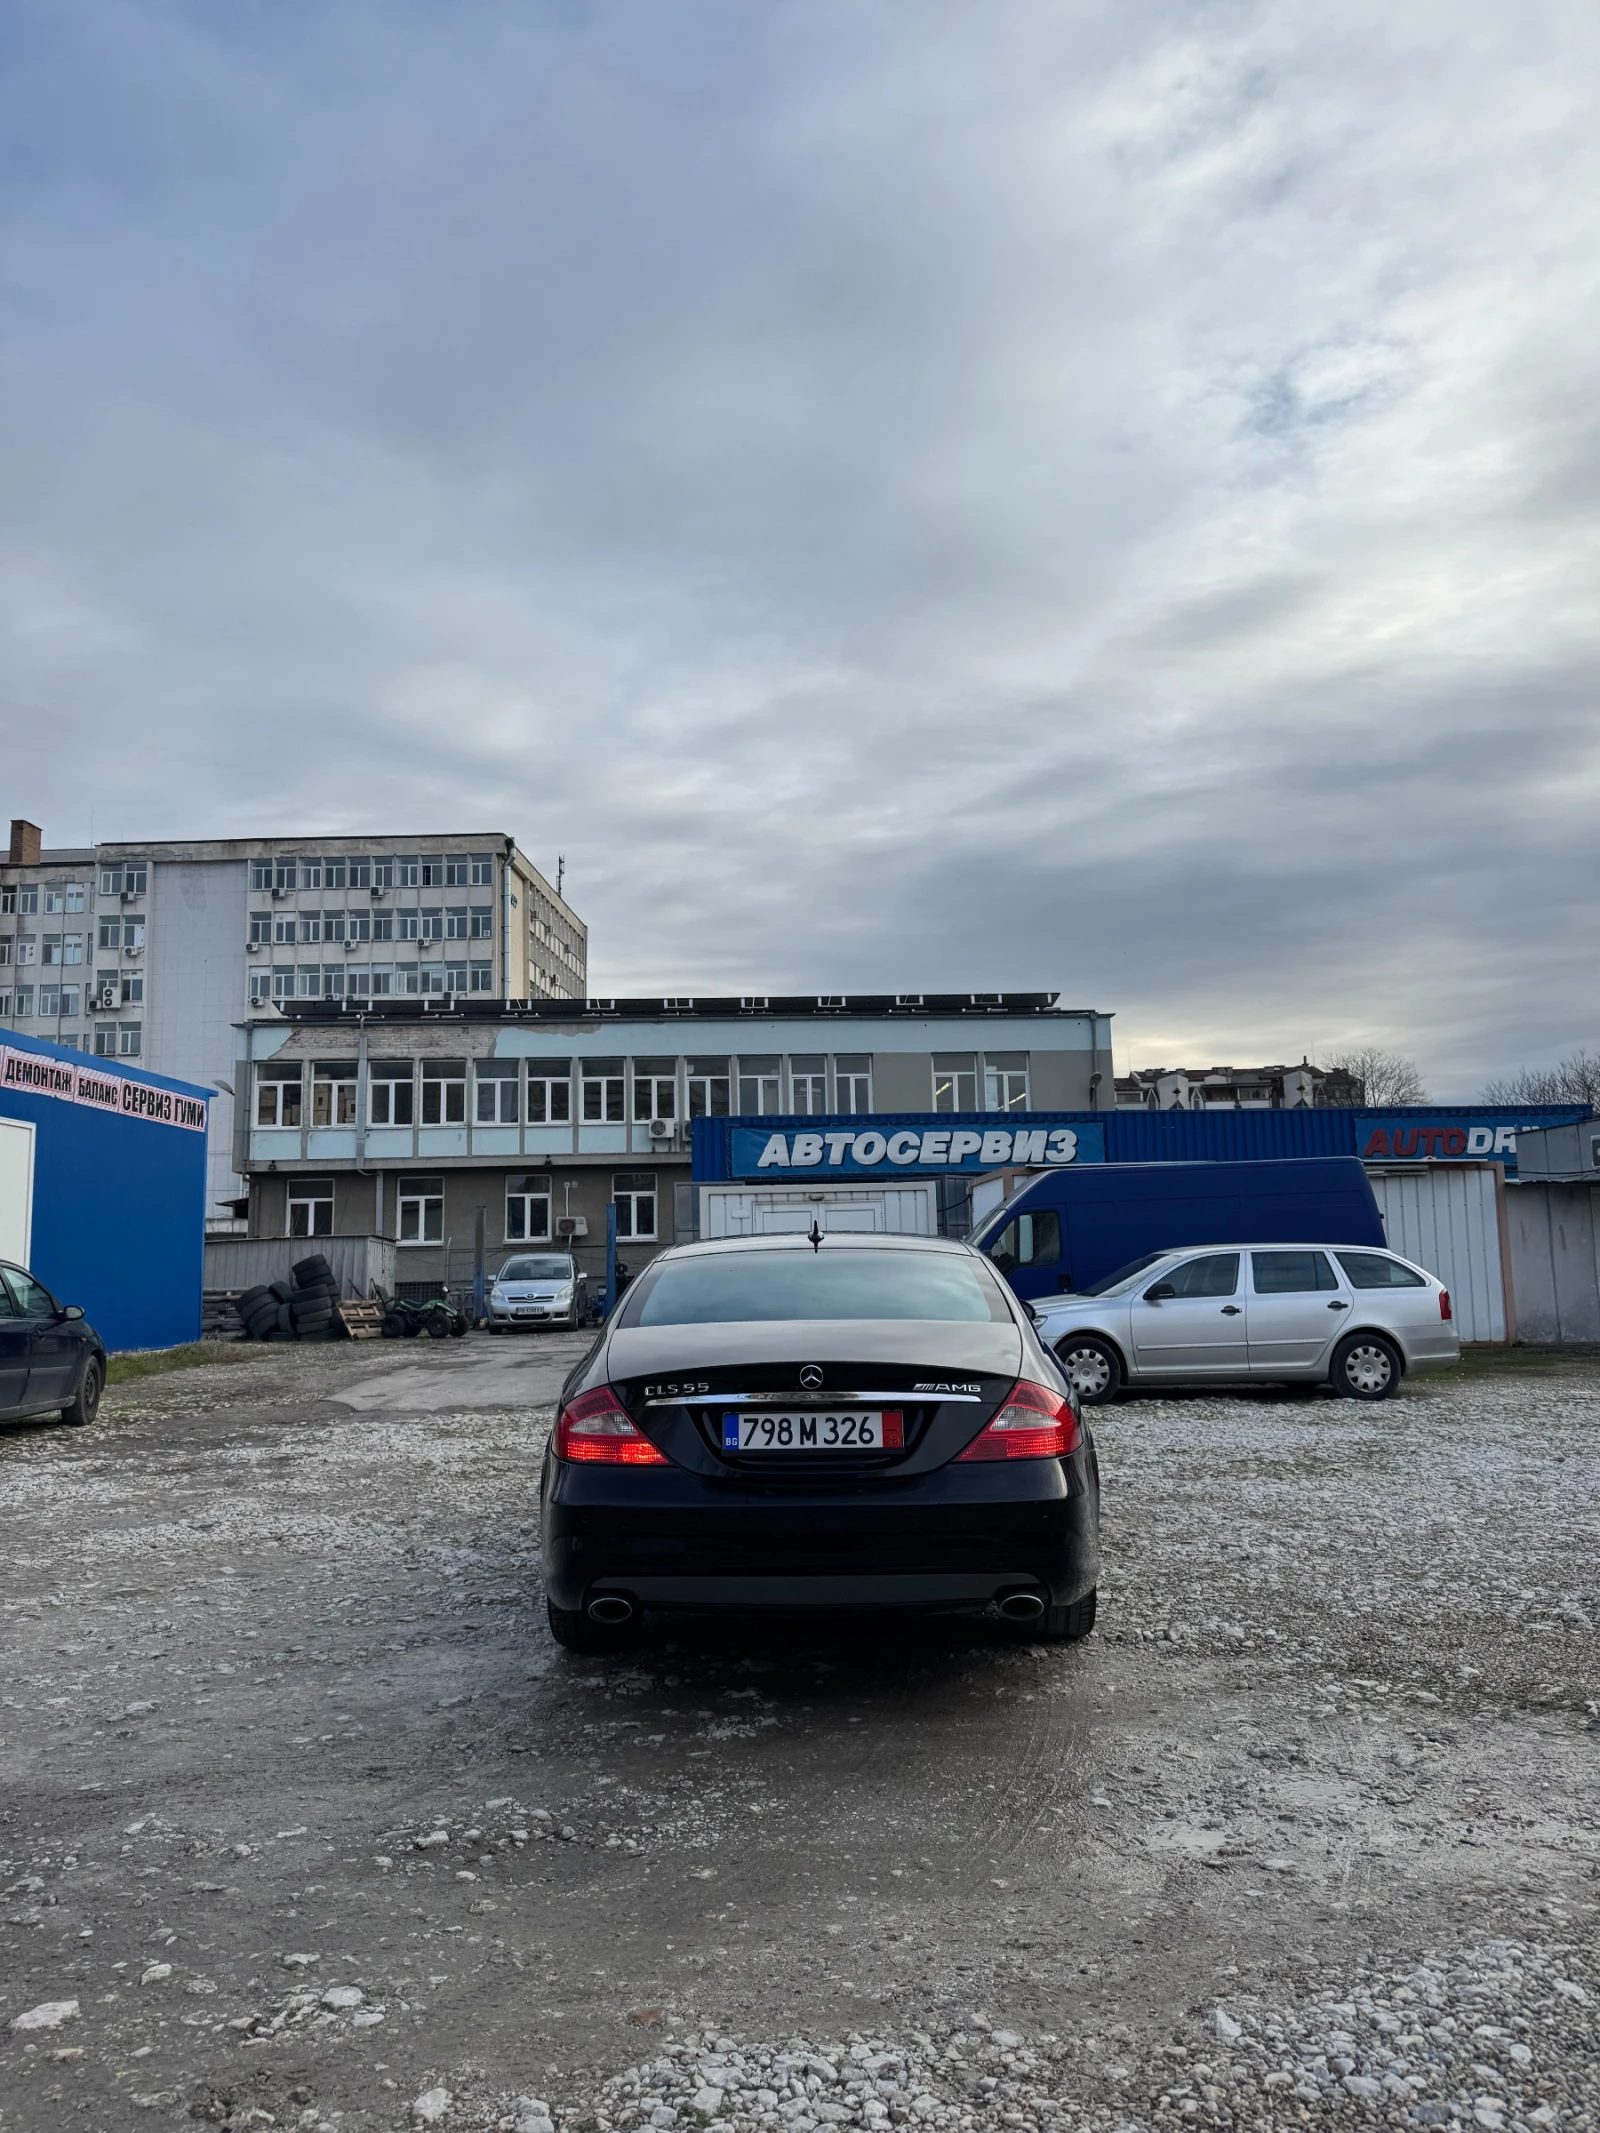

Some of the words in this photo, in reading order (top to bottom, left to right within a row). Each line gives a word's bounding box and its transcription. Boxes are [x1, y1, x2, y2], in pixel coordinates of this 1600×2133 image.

[5, 1058, 72, 1093] ДЕМОНТАЖ
[78, 1077, 118, 1105] БАЛАНС
[123, 1084, 171, 1121] СЕРВИЗ
[174, 1098, 205, 1128] ГУМИ
[757, 1129, 1077, 1167] АВТОСЕРВИЗ
[644, 1384, 678, 1396] CLS
[683, 1382, 709, 1393] 55
[935, 1383, 981, 1392] AMG
[725, 1437, 738, 1446] BG
[743, 1417, 793, 1447] 798
[799, 1417, 818, 1446] M
[823, 1416, 875, 1445] 326
